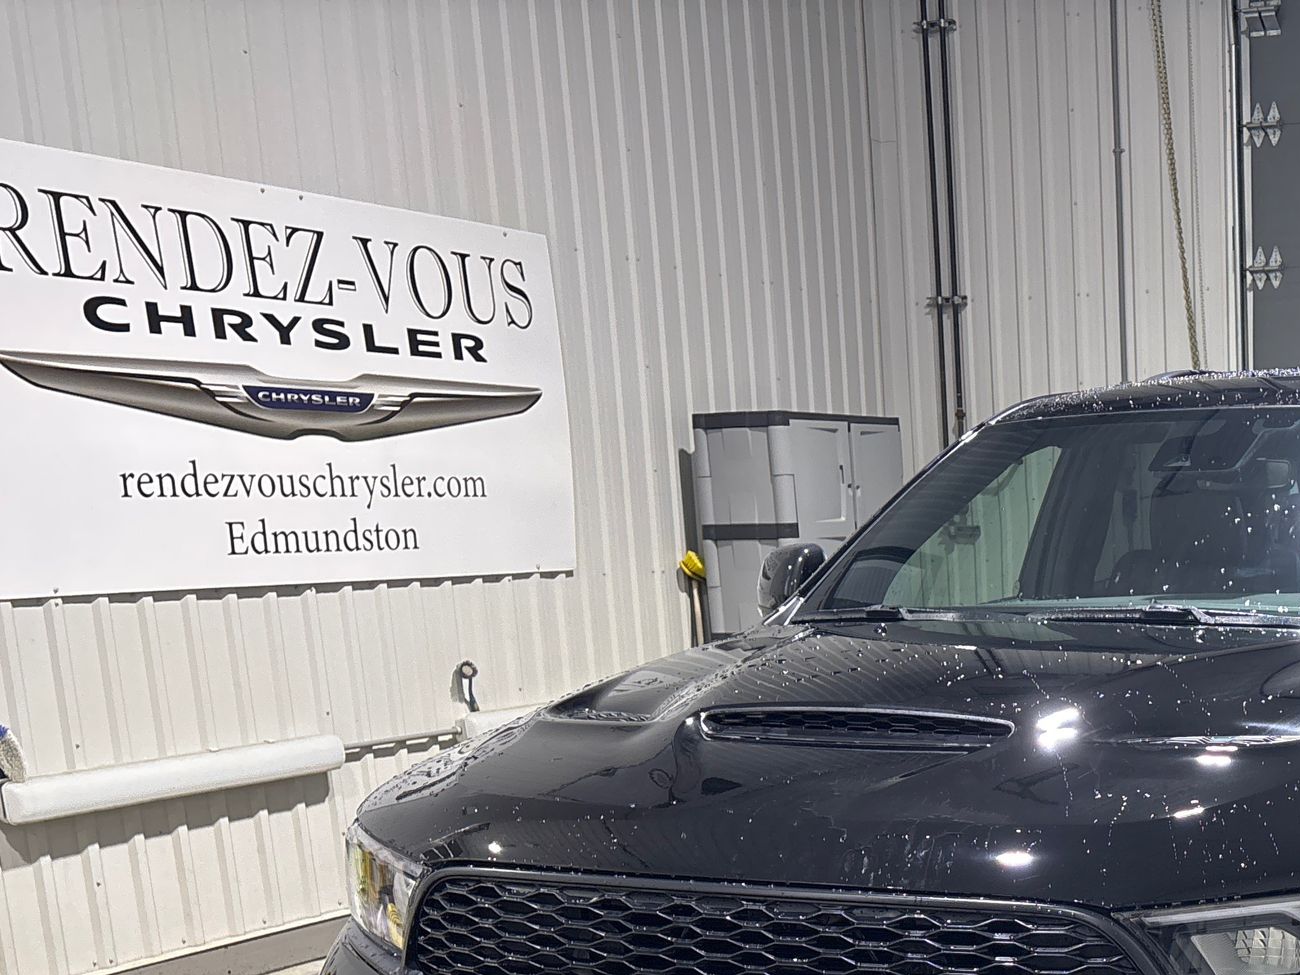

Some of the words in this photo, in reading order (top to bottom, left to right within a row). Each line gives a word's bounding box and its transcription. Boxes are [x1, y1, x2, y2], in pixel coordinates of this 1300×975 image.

[0, 182, 533, 330] RENDEZ-VOUS
[83, 295, 488, 364] CHRYSLER
[257, 389, 362, 408] CHRYSLER
[119, 459, 488, 510] rendezvouschrysler.com
[226, 518, 420, 556] Edmundston
